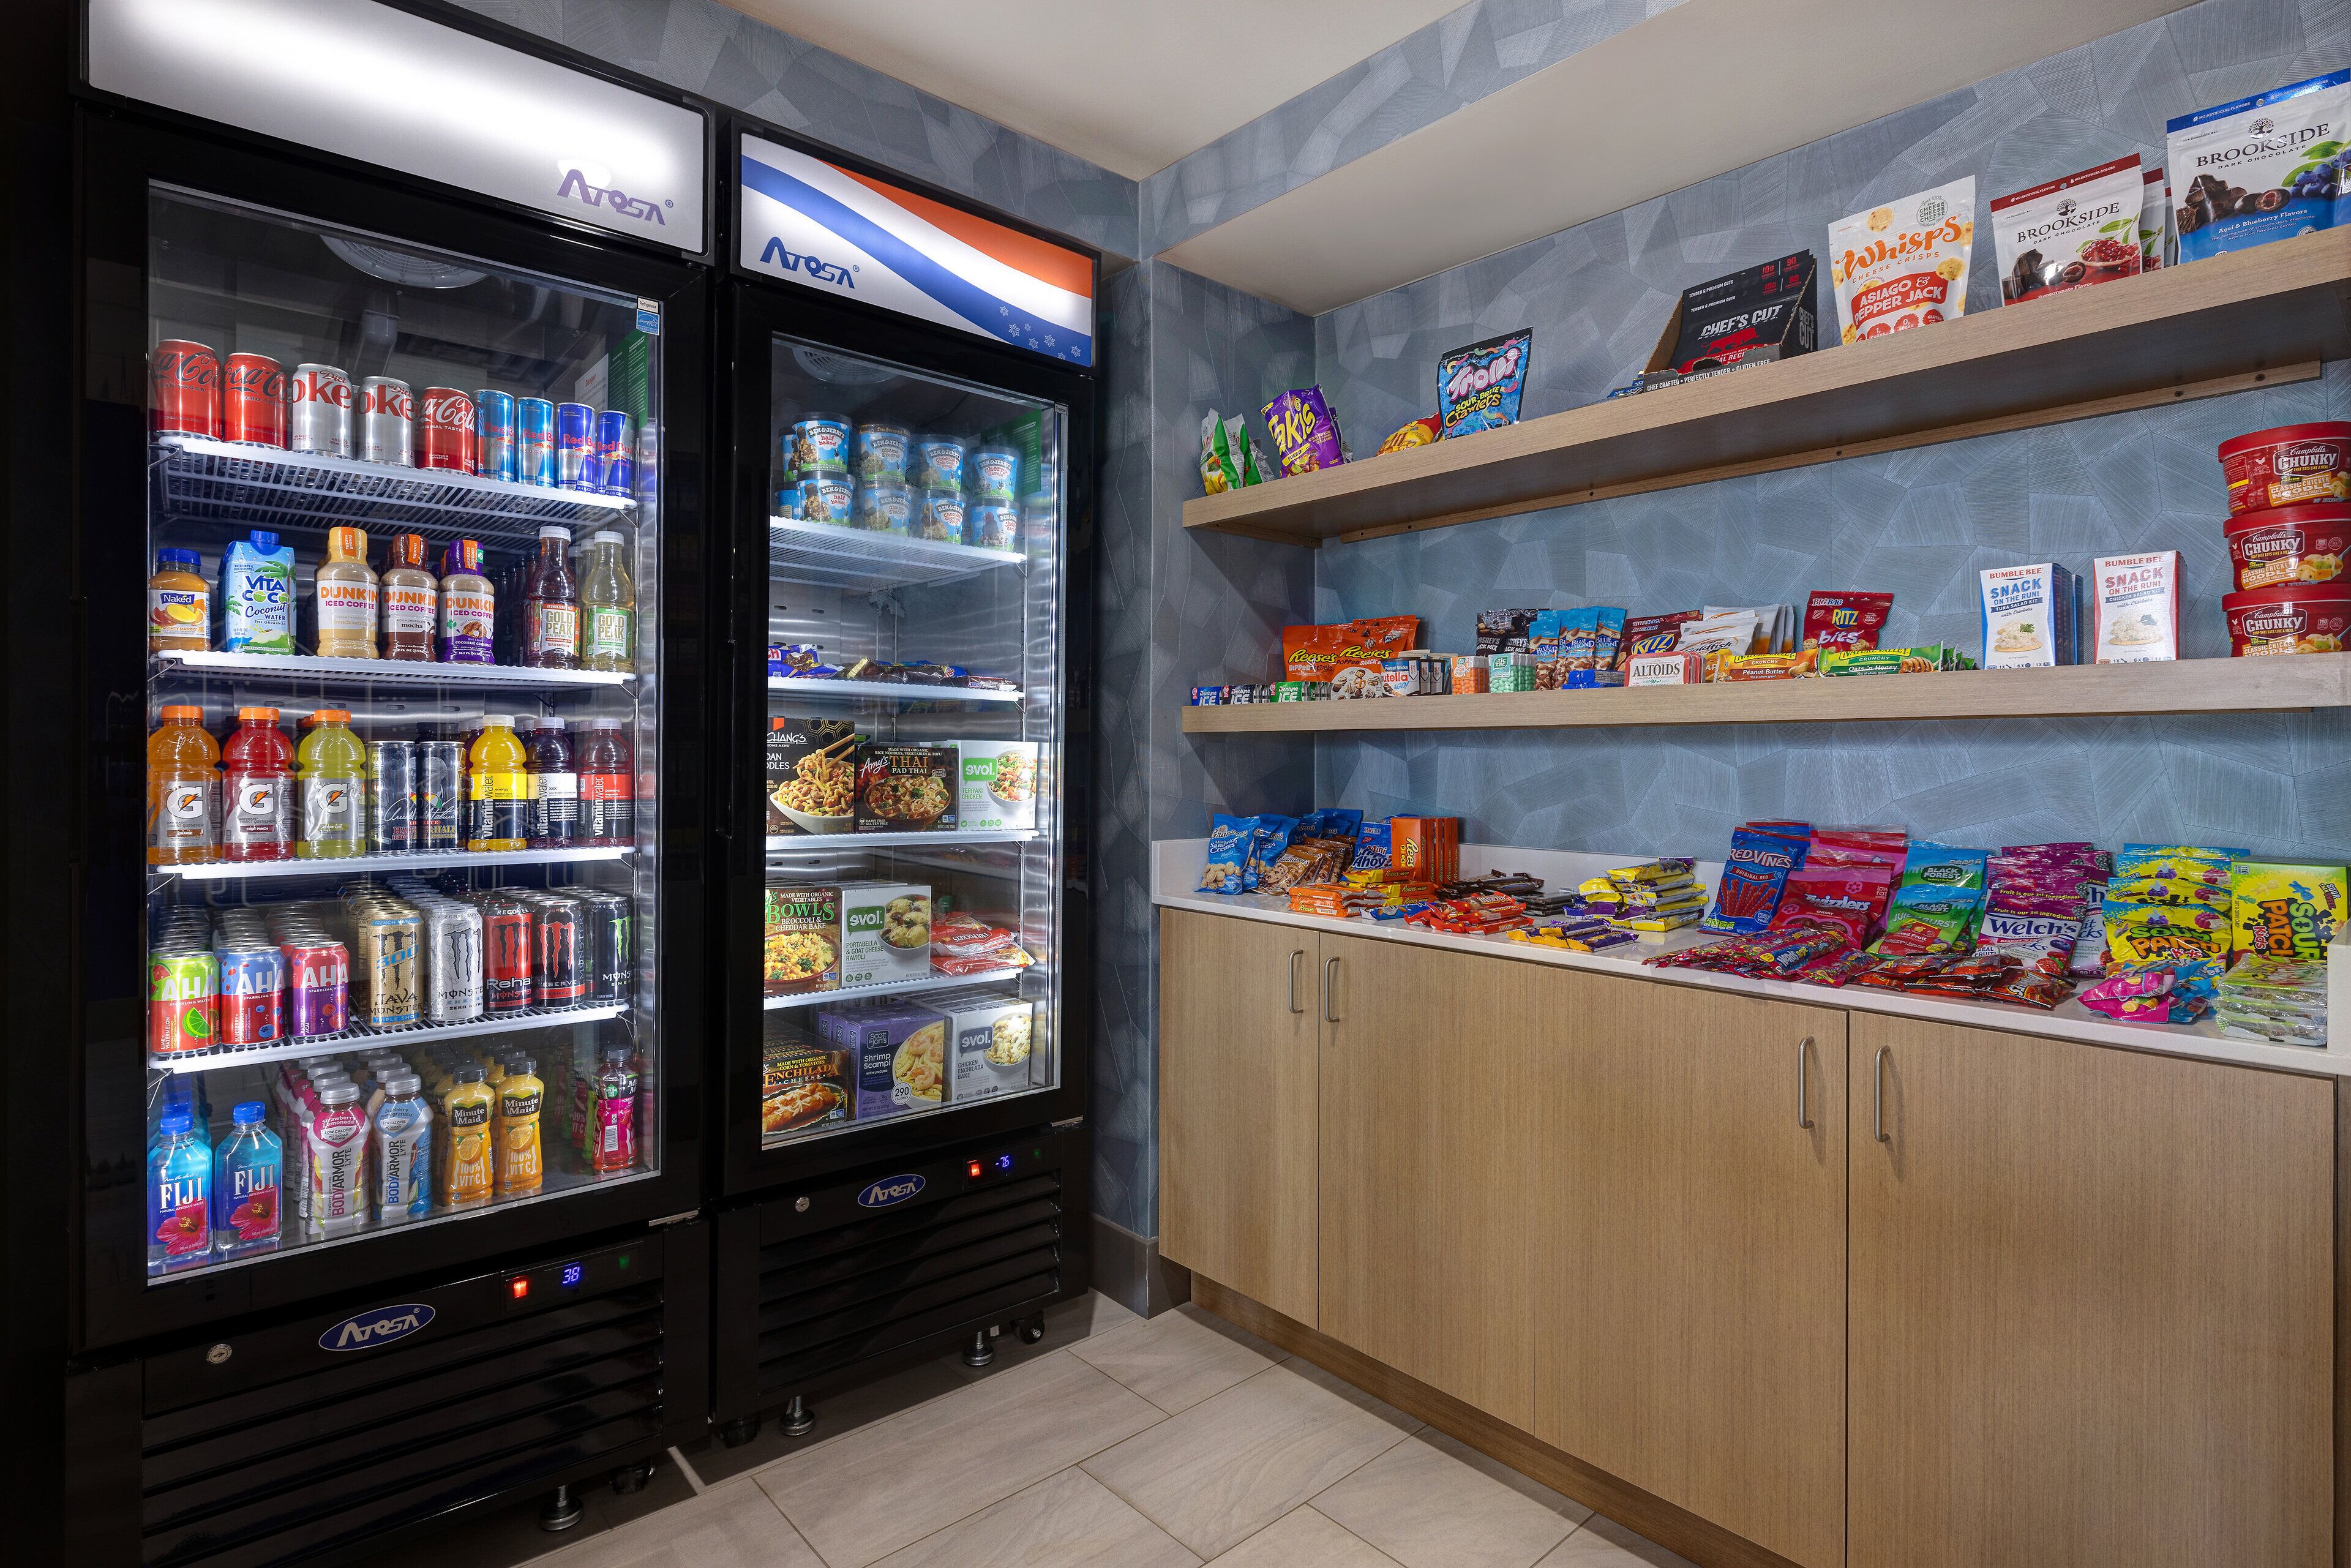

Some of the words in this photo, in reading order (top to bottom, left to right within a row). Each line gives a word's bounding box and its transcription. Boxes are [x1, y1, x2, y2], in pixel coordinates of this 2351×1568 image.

[2196, 123, 2330, 167] BROOKSIDE
[2248, 144, 2306, 162] CHOCOLATE
[2017, 201, 2120, 243] BROOKSIDE
[2218, 225, 2235, 234] Açaí
[2242, 214, 2279, 227] Blueberry
[2279, 208, 2308, 219] Flavors
[2033, 236, 2052, 244] DARK
[2055, 220, 2101, 237] CHOCOLATE
[1834, 216, 1962, 280] Whisps
[1853, 264, 1891, 283] CHEESE
[1897, 251, 1940, 264] CRISPS
[1860, 280, 1911, 307] ASIAGO
[1916, 277, 1930, 287] &
[639, 300, 657, 309] Refrigerator
[1855, 296, 1902, 325] PEPPER
[1905, 287, 1943, 302] JACK
[1701, 313, 1748, 337] CHEF'S
[1752, 305, 1782, 323] CUT
[585, 373, 597, 387] Danger
[1449, 348, 1520, 399] Trolli
[1647, 383, 1659, 391] CHEF
[1659, 379, 1679, 388] CRAFTED
[1684, 372, 1710, 383] PERFECTLY
[1711, 368, 1730, 377] TENDER
[1736, 362, 1755, 372] GLUTEN
[293, 371, 351, 409] oke
[1455, 398, 1477, 412] SOUR
[1479, 386, 1501, 400] BRITE
[1445, 393, 1501, 427] Crawlers
[1267, 403, 1316, 452] Takis
[597, 441, 615, 451] Red
[2290, 444, 2326, 455] Campbell's
[2278, 451, 2337, 470] CHUNKY
[984, 467, 1008, 475] Cherry
[2244, 538, 2301, 556] CHUNKY
[2105, 558, 2145, 568] BUMBLE
[1989, 569, 2024, 579] BUMBLE
[2105, 566, 2164, 589] SNACK
[246, 576, 285, 591] VITA
[1990, 578, 2042, 599] SNACK
[163, 595, 192, 603] Naked
[242, 591, 290, 603] COCO
[2021, 591, 2039, 601] RUN!
[246, 602, 286, 617] Coconut
[348, 601, 375, 610] COFFEE
[546, 611, 572, 623] GOLD
[1832, 608, 1859, 626] RITZ
[546, 623, 572, 634] PEAK
[1818, 630, 1859, 645] bits
[1633, 662, 1681, 677] ALTOIDS
[1278, 691, 1297, 702] ICE
[860, 756, 888, 778] Amy's
[891, 756, 929, 768] THAI
[167, 786, 203, 819] G
[1736, 868, 1758, 879] ORIGINAL
[1804, 893, 1871, 910] Twizzlers
[766, 903, 835, 923] BOWLS
[1989, 918, 2077, 936] Welch's
[2129, 926, 2211, 940] SOUR
[2289, 902, 2320, 959] SOUR
[2132, 937, 2220, 956] PATCH
[2253, 926, 2266, 949] Kids
[235, 969, 285, 994] AHA
[302, 963, 348, 988] AHA
[161, 975, 215, 1001] AHA
[375, 988, 418, 1006] JAVA
[370, 1002, 423, 1015] MONSTER
[863, 1053, 891, 1063] Shrimp
[863, 1060, 891, 1070] Scampi
[958, 1065, 984, 1074] ENCHILADA
[894, 1086, 910, 1098] 290
[504, 1097, 539, 1109] Minute
[509, 1105, 535, 1113] Maid
[454, 1108, 485, 1118] Minute
[457, 1116, 482, 1125] Maid
[388, 1140, 400, 1204] BODYARMOR
[460, 1161, 481, 1174] 100%
[234, 1165, 274, 1196] FIJI
[332, 1150, 344, 1217] BODYARMOR
[159, 1177, 203, 1209] FIJI
[563, 1267, 580, 1284] 38
